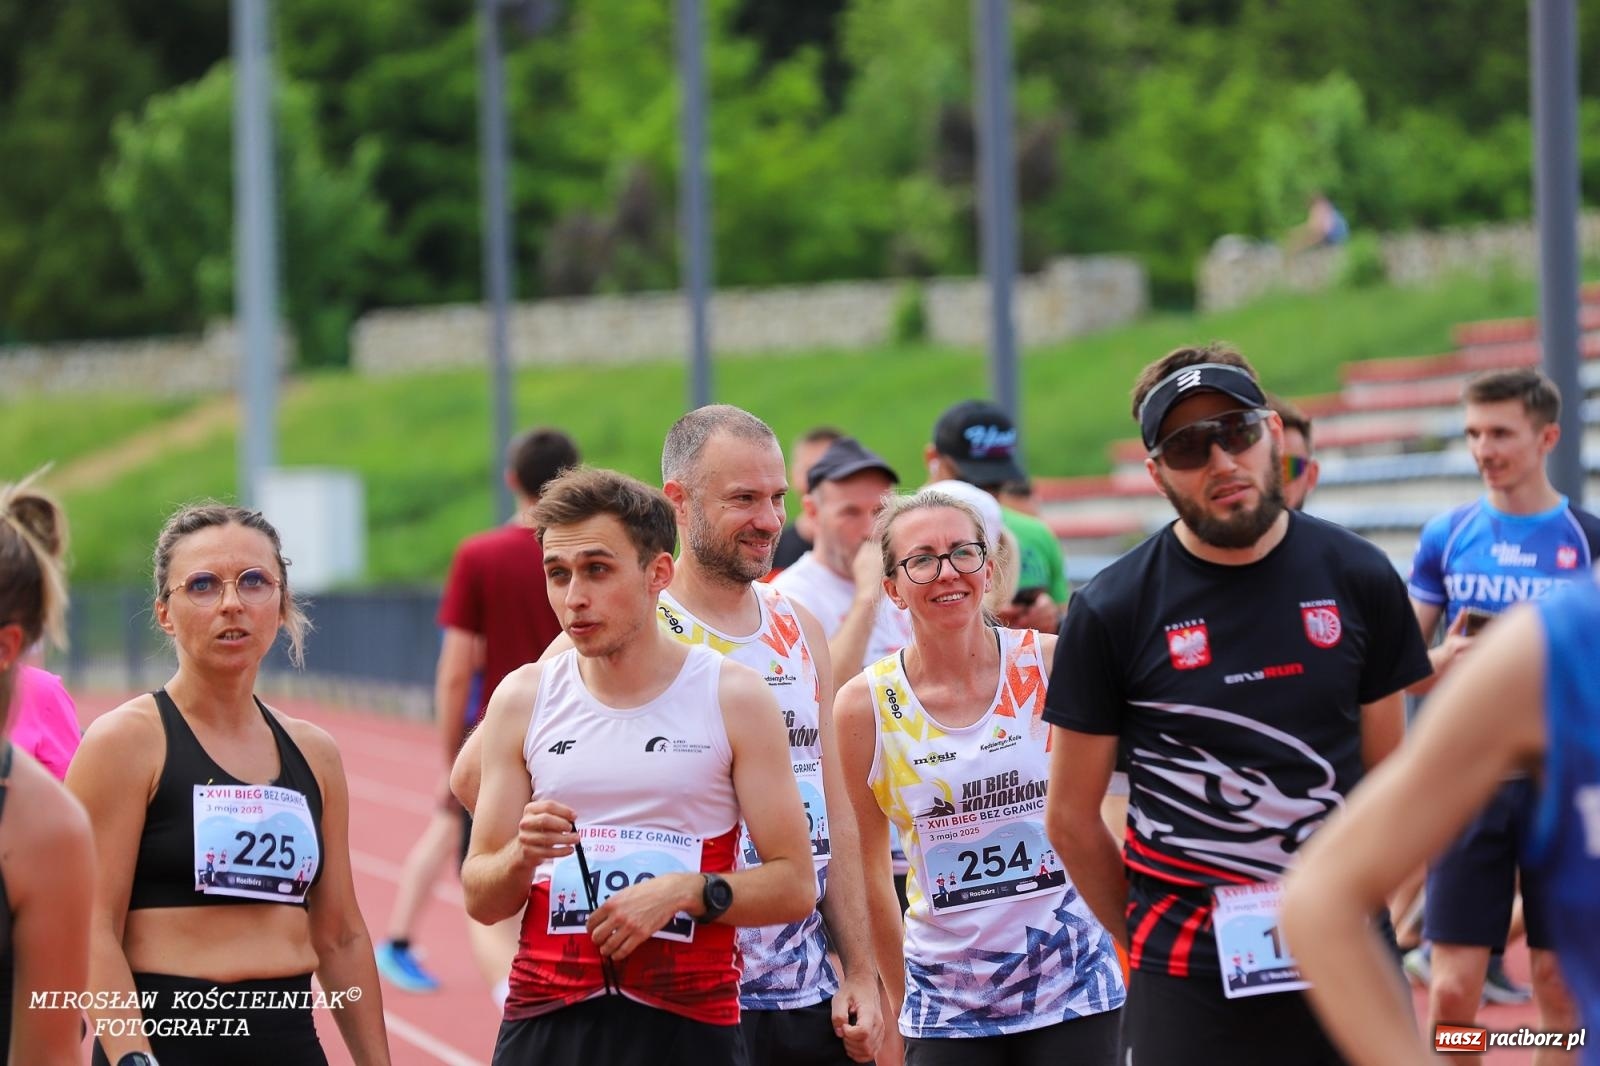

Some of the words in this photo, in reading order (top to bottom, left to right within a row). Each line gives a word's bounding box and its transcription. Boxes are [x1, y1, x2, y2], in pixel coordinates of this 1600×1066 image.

[1164, 618, 1206, 632] POLSKA
[885, 688, 903, 719] deep
[548, 740, 576, 755] 4F
[962, 780, 984, 798] XII
[983, 770, 1019, 792] BIEG
[207, 789, 231, 799] XVII
[235, 789, 262, 800] BIEG
[264, 790, 279, 800] BEZ
[214, 805, 238, 814] maja
[240, 806, 263, 814] 2025
[927, 819, 950, 830] XVII
[951, 814, 977, 826] BIEG
[979, 809, 1001, 821] BEZ
[1003, 800, 1044, 816] GRANIC
[590, 828, 617, 839] BIEG
[620, 829, 643, 841] BEZ
[645, 832, 692, 847] GRANIC
[929, 834, 935, 842] 3
[936, 831, 958, 842] maja
[959, 827, 980, 837] 2025
[233, 830, 295, 871] 225
[594, 844, 616, 853] 2025
[957, 841, 1033, 882] 254
[969, 888, 996, 898] Racibórz
